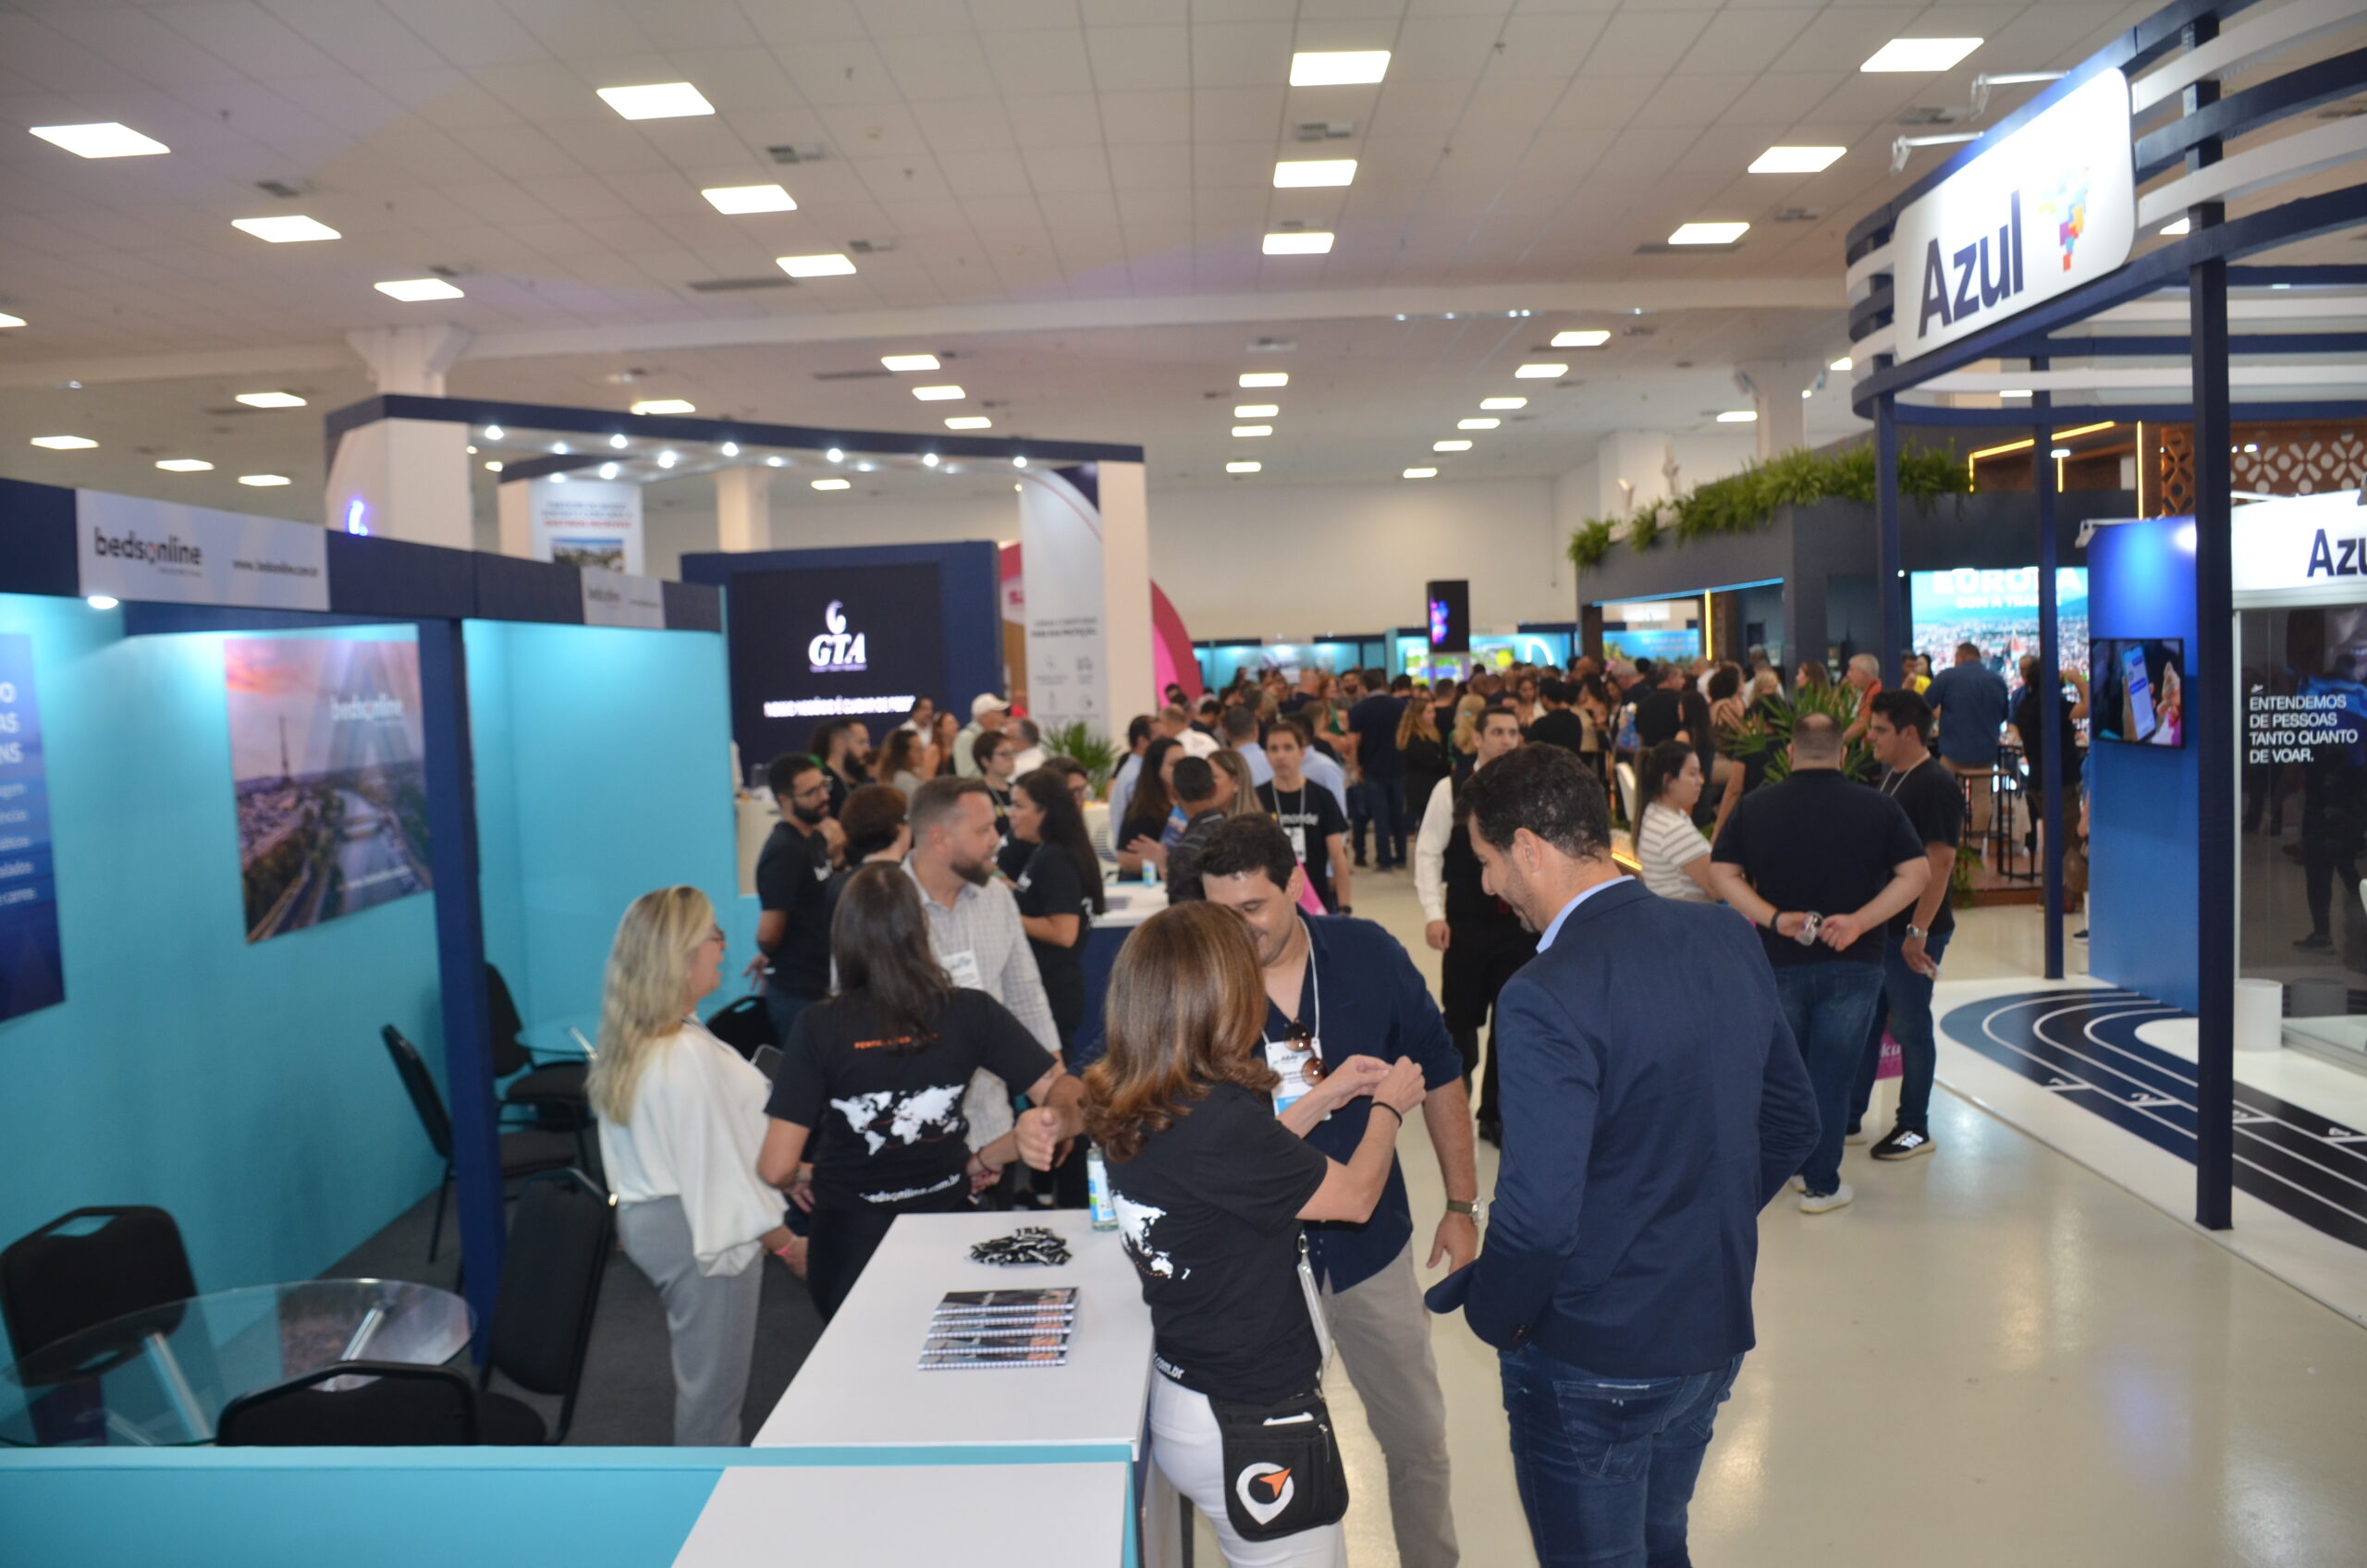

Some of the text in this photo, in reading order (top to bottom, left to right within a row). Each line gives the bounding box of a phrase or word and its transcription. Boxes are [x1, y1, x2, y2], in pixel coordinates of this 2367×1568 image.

[1918, 189, 2024, 340] Azul
[808, 631, 866, 667] GTA
[2250, 693, 2347, 711] ENTENDEMOS
[2250, 712, 2337, 729] DE PESSOAS
[2250, 729, 2359, 746] TANTO QUANTO
[2250, 748, 2314, 764] DE VOAR.
